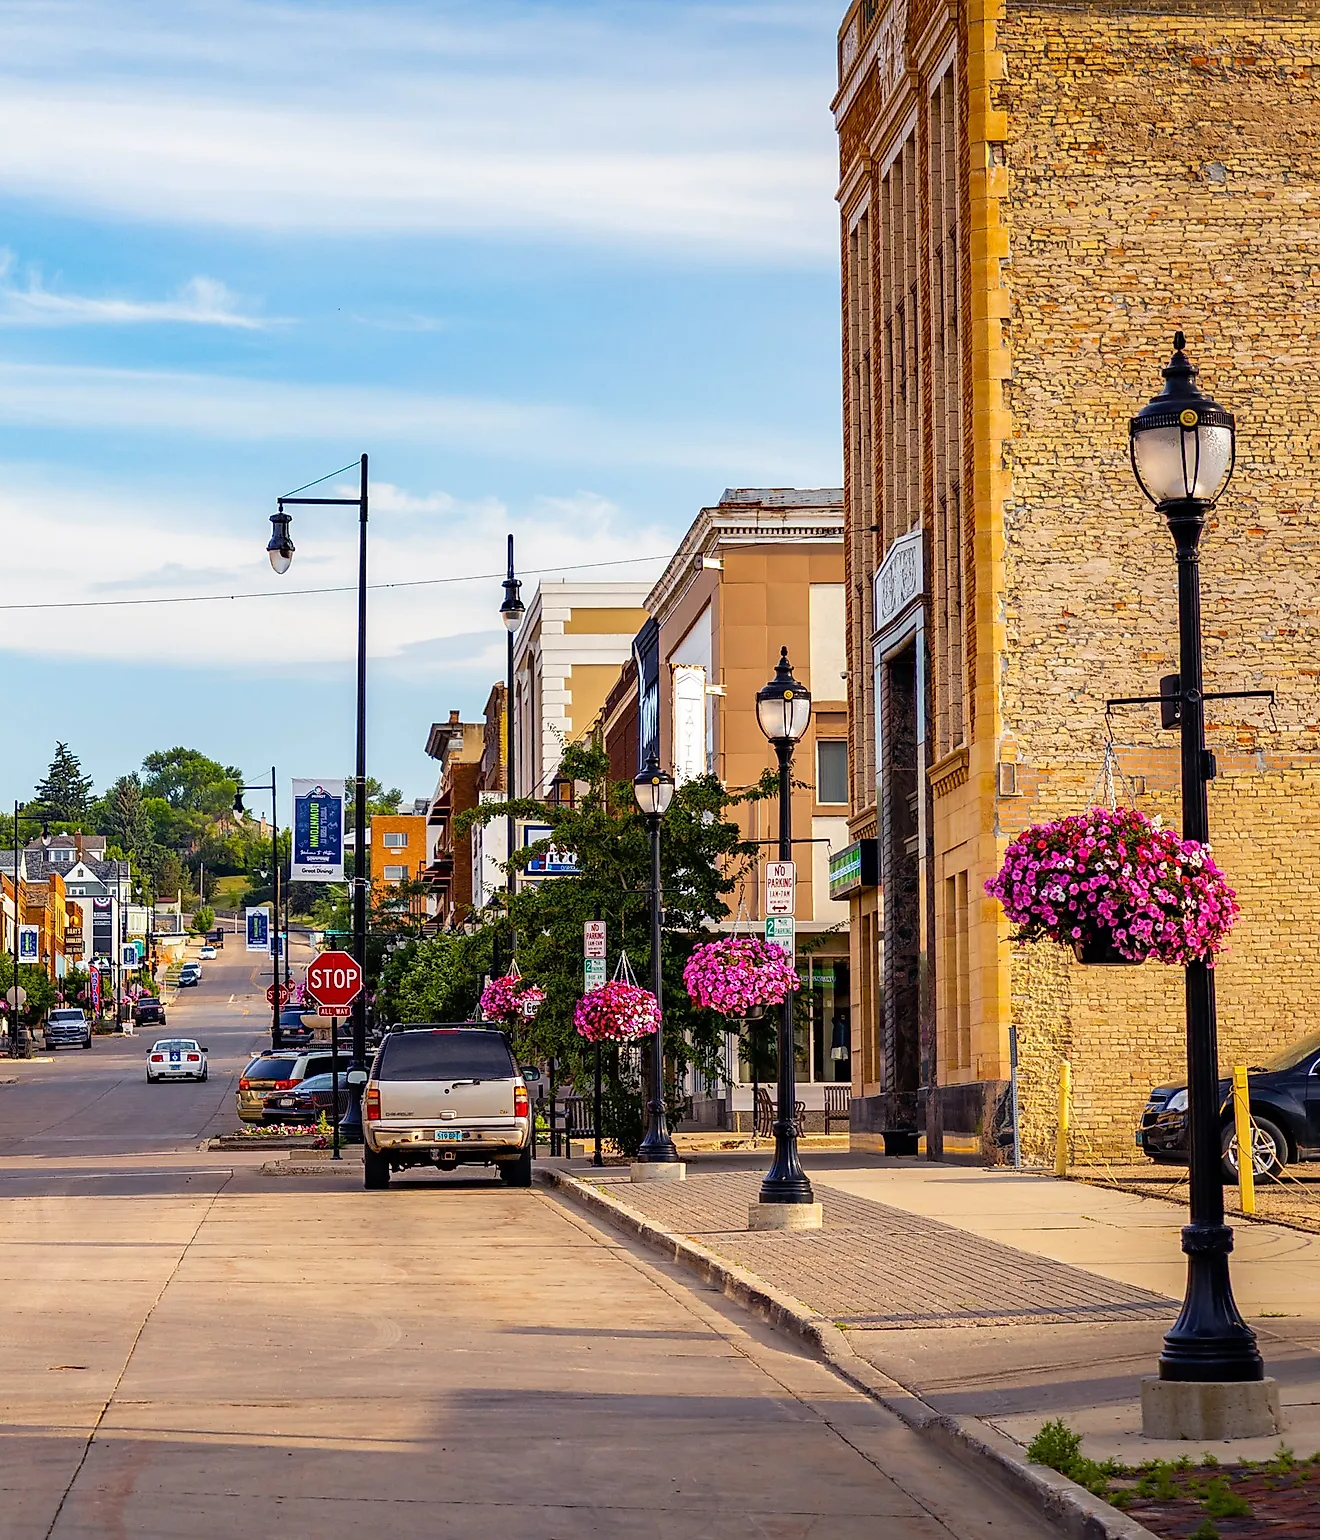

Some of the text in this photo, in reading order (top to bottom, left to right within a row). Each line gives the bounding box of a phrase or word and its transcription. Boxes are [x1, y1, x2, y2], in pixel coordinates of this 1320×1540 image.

[309, 803, 319, 848] DOWNTOWN
[774, 866, 786, 876] NO
[767, 878, 792, 888] PARKING
[767, 920, 774, 935] 2
[774, 927, 792, 935] PARKING
[586, 961, 592, 971] 2
[310, 968, 358, 989] STOP
[267, 990, 287, 1000] SOP
